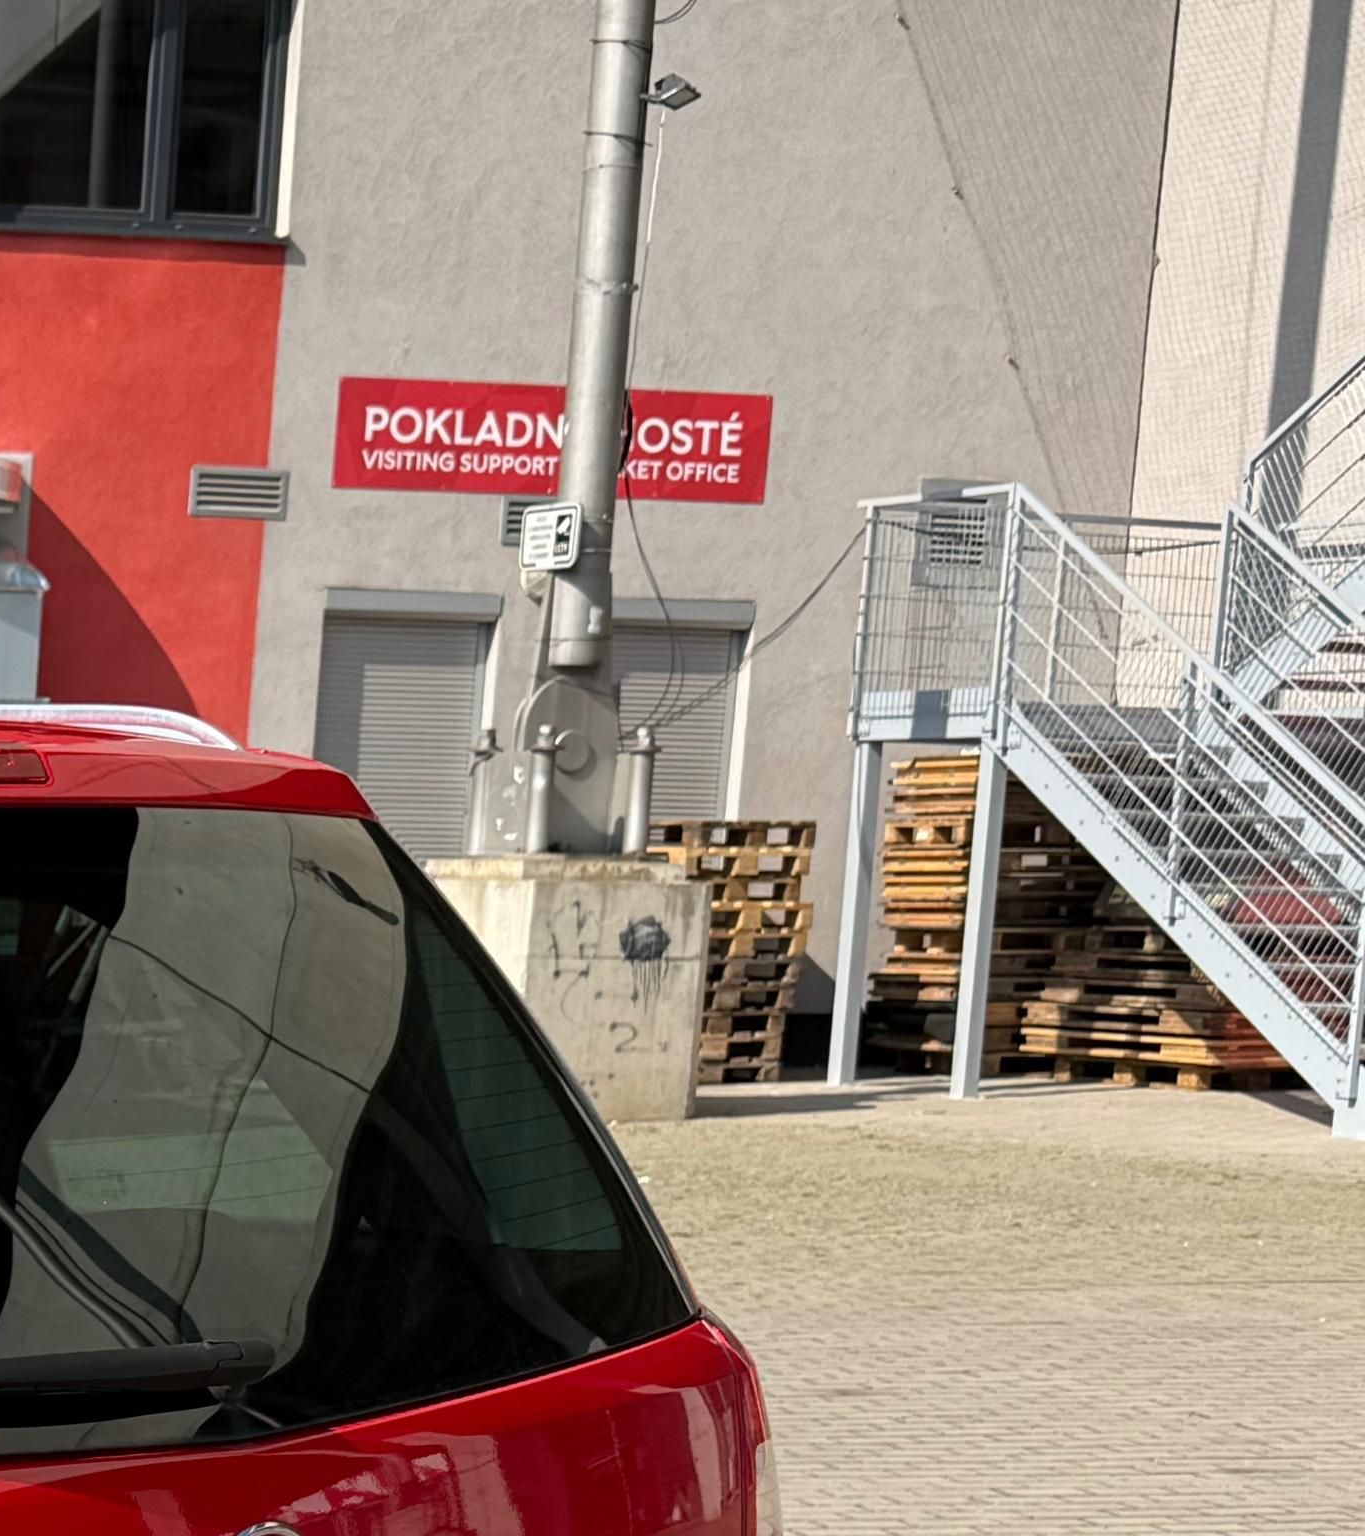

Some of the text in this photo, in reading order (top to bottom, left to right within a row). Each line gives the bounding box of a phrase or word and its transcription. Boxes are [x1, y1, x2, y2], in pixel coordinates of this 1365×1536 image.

[364, 405, 743, 457] POKLADN OSTÉ
[362, 449, 740, 484] VISITING SUPPORT KET OFFICE
